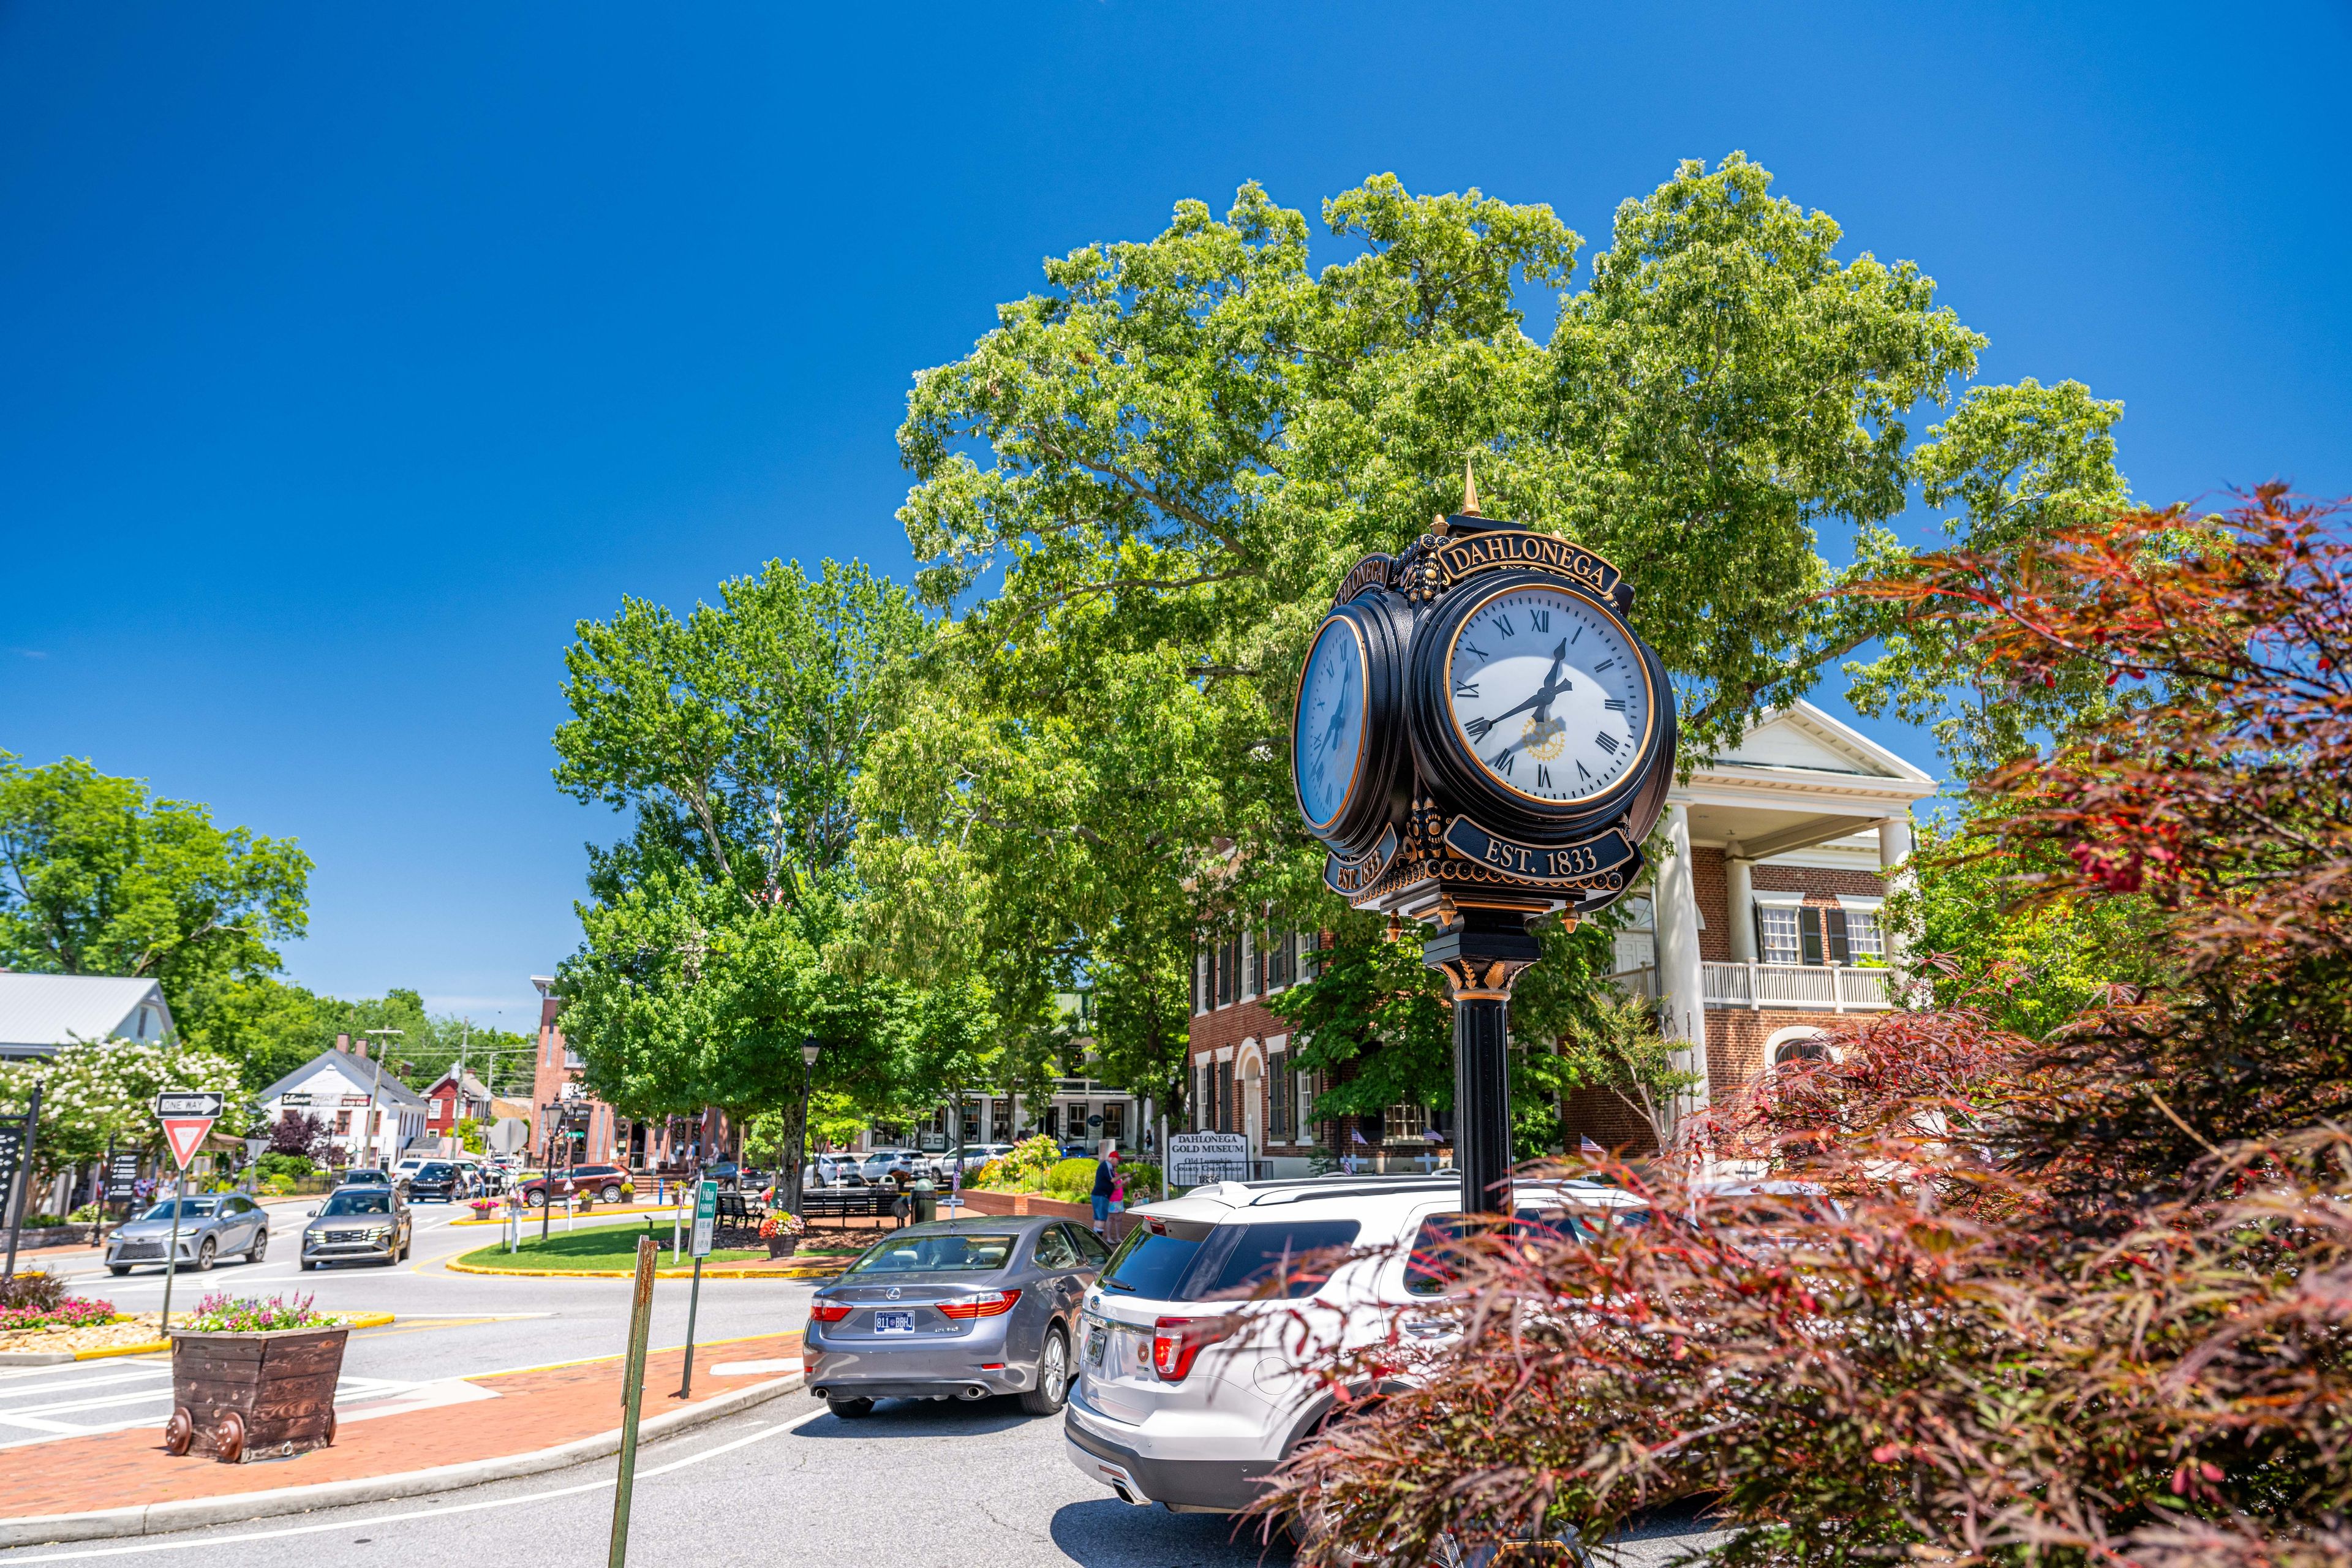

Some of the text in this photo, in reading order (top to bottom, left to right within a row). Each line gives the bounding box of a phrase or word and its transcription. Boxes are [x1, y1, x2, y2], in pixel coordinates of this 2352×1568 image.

[1448, 537, 1605, 589] DAHLONEGA
[1335, 560, 1387, 607] HLONEGA
[1491, 614, 1515, 640] XI
[1530, 609, 1549, 633] XII
[1571, 626, 1583, 645] I
[1465, 641, 1489, 663] X
[1594, 658, 1615, 673] II
[1457, 680, 1479, 698] IX
[1604, 699, 1626, 712] III
[1494, 748, 1515, 776] VII
[1575, 759, 1591, 782] V
[1538, 764, 1552, 788] VI
[1484, 837, 1597, 875] EST. 1833
[1336, 850, 1383, 890] EST. 1833
[164, 1101, 203, 1110] ONE WAY
[699, 1203, 714, 1213] PARKING
[876, 1317, 913, 1328] 811 BBHJ
